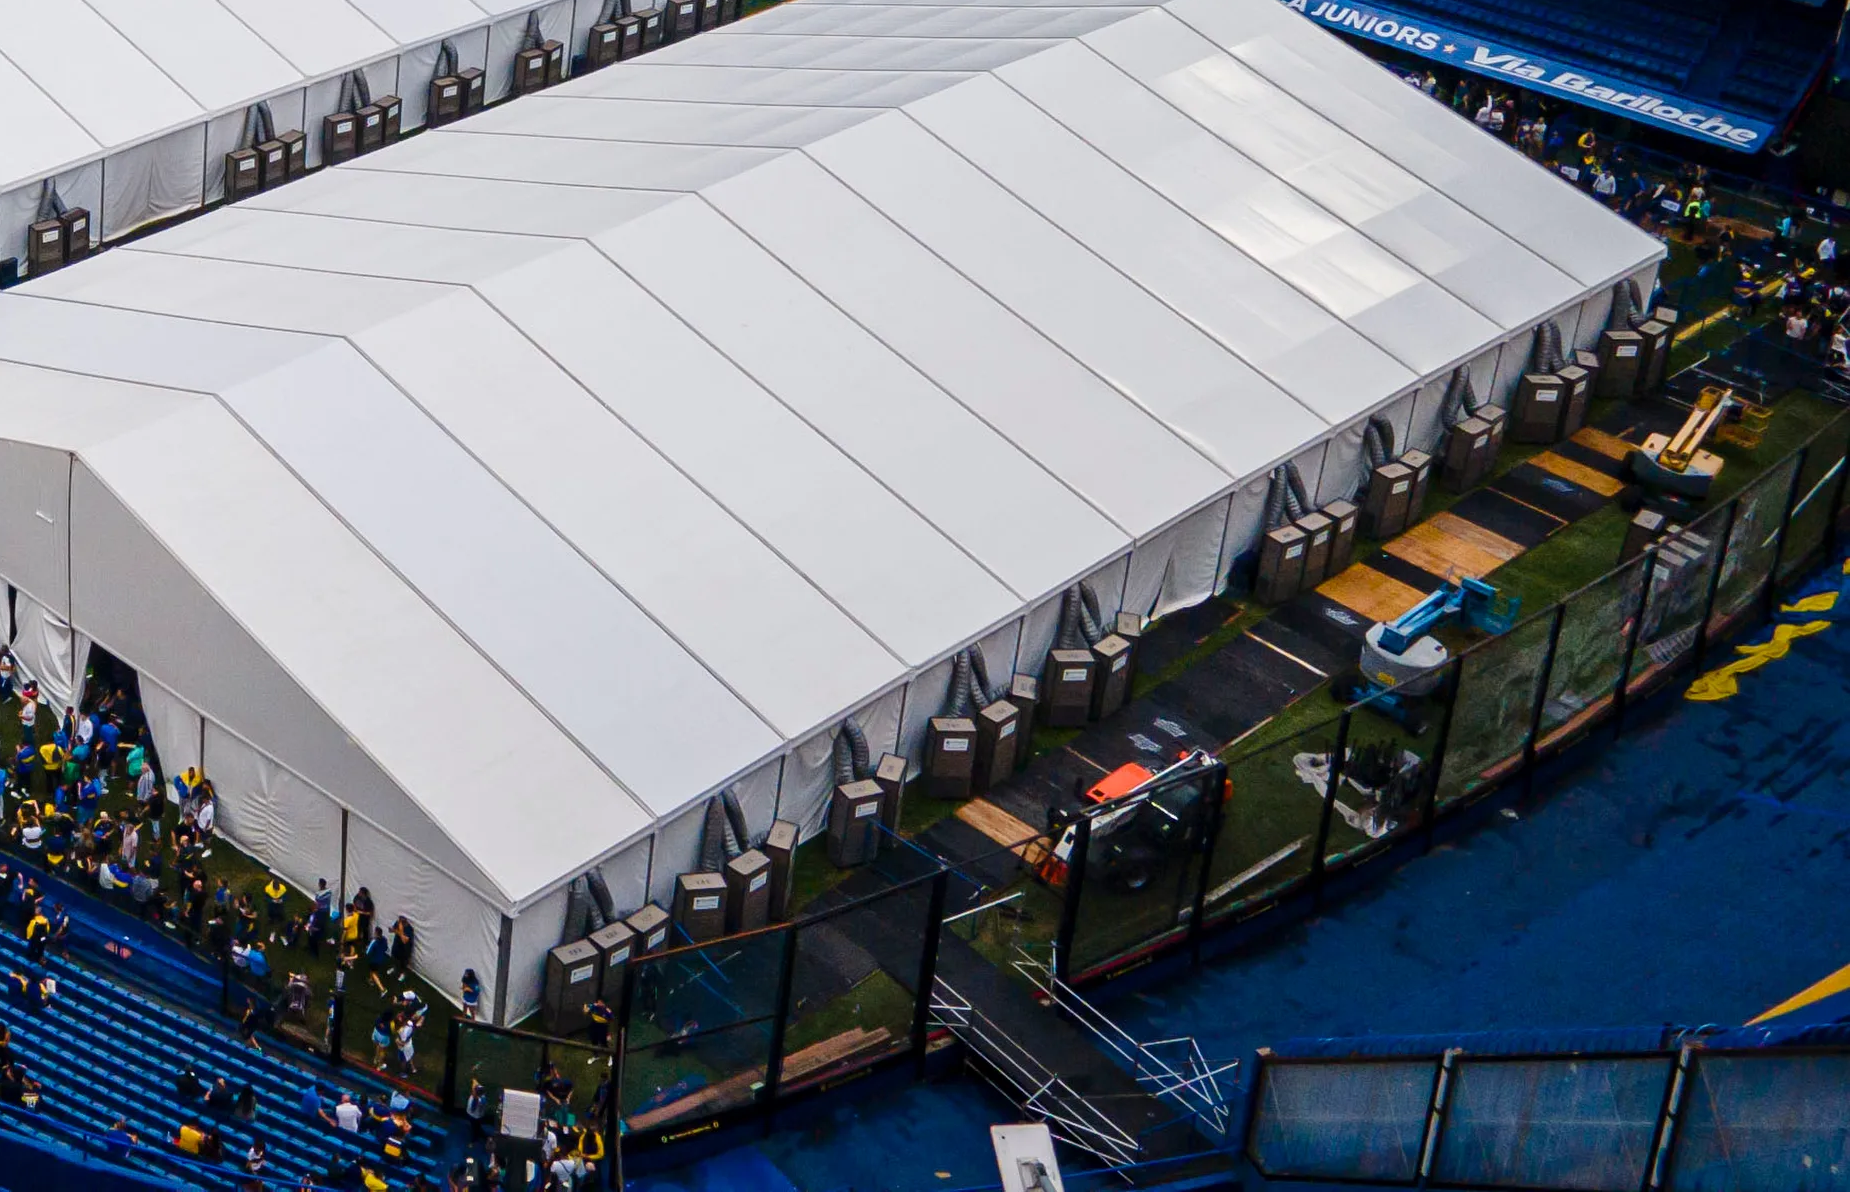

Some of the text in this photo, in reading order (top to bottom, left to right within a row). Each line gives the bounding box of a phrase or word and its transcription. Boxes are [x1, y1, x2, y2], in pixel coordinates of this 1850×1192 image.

[1311, 0, 1440, 52] JUNIORS
[1468, 45, 1758, 143] Via Bariloche
